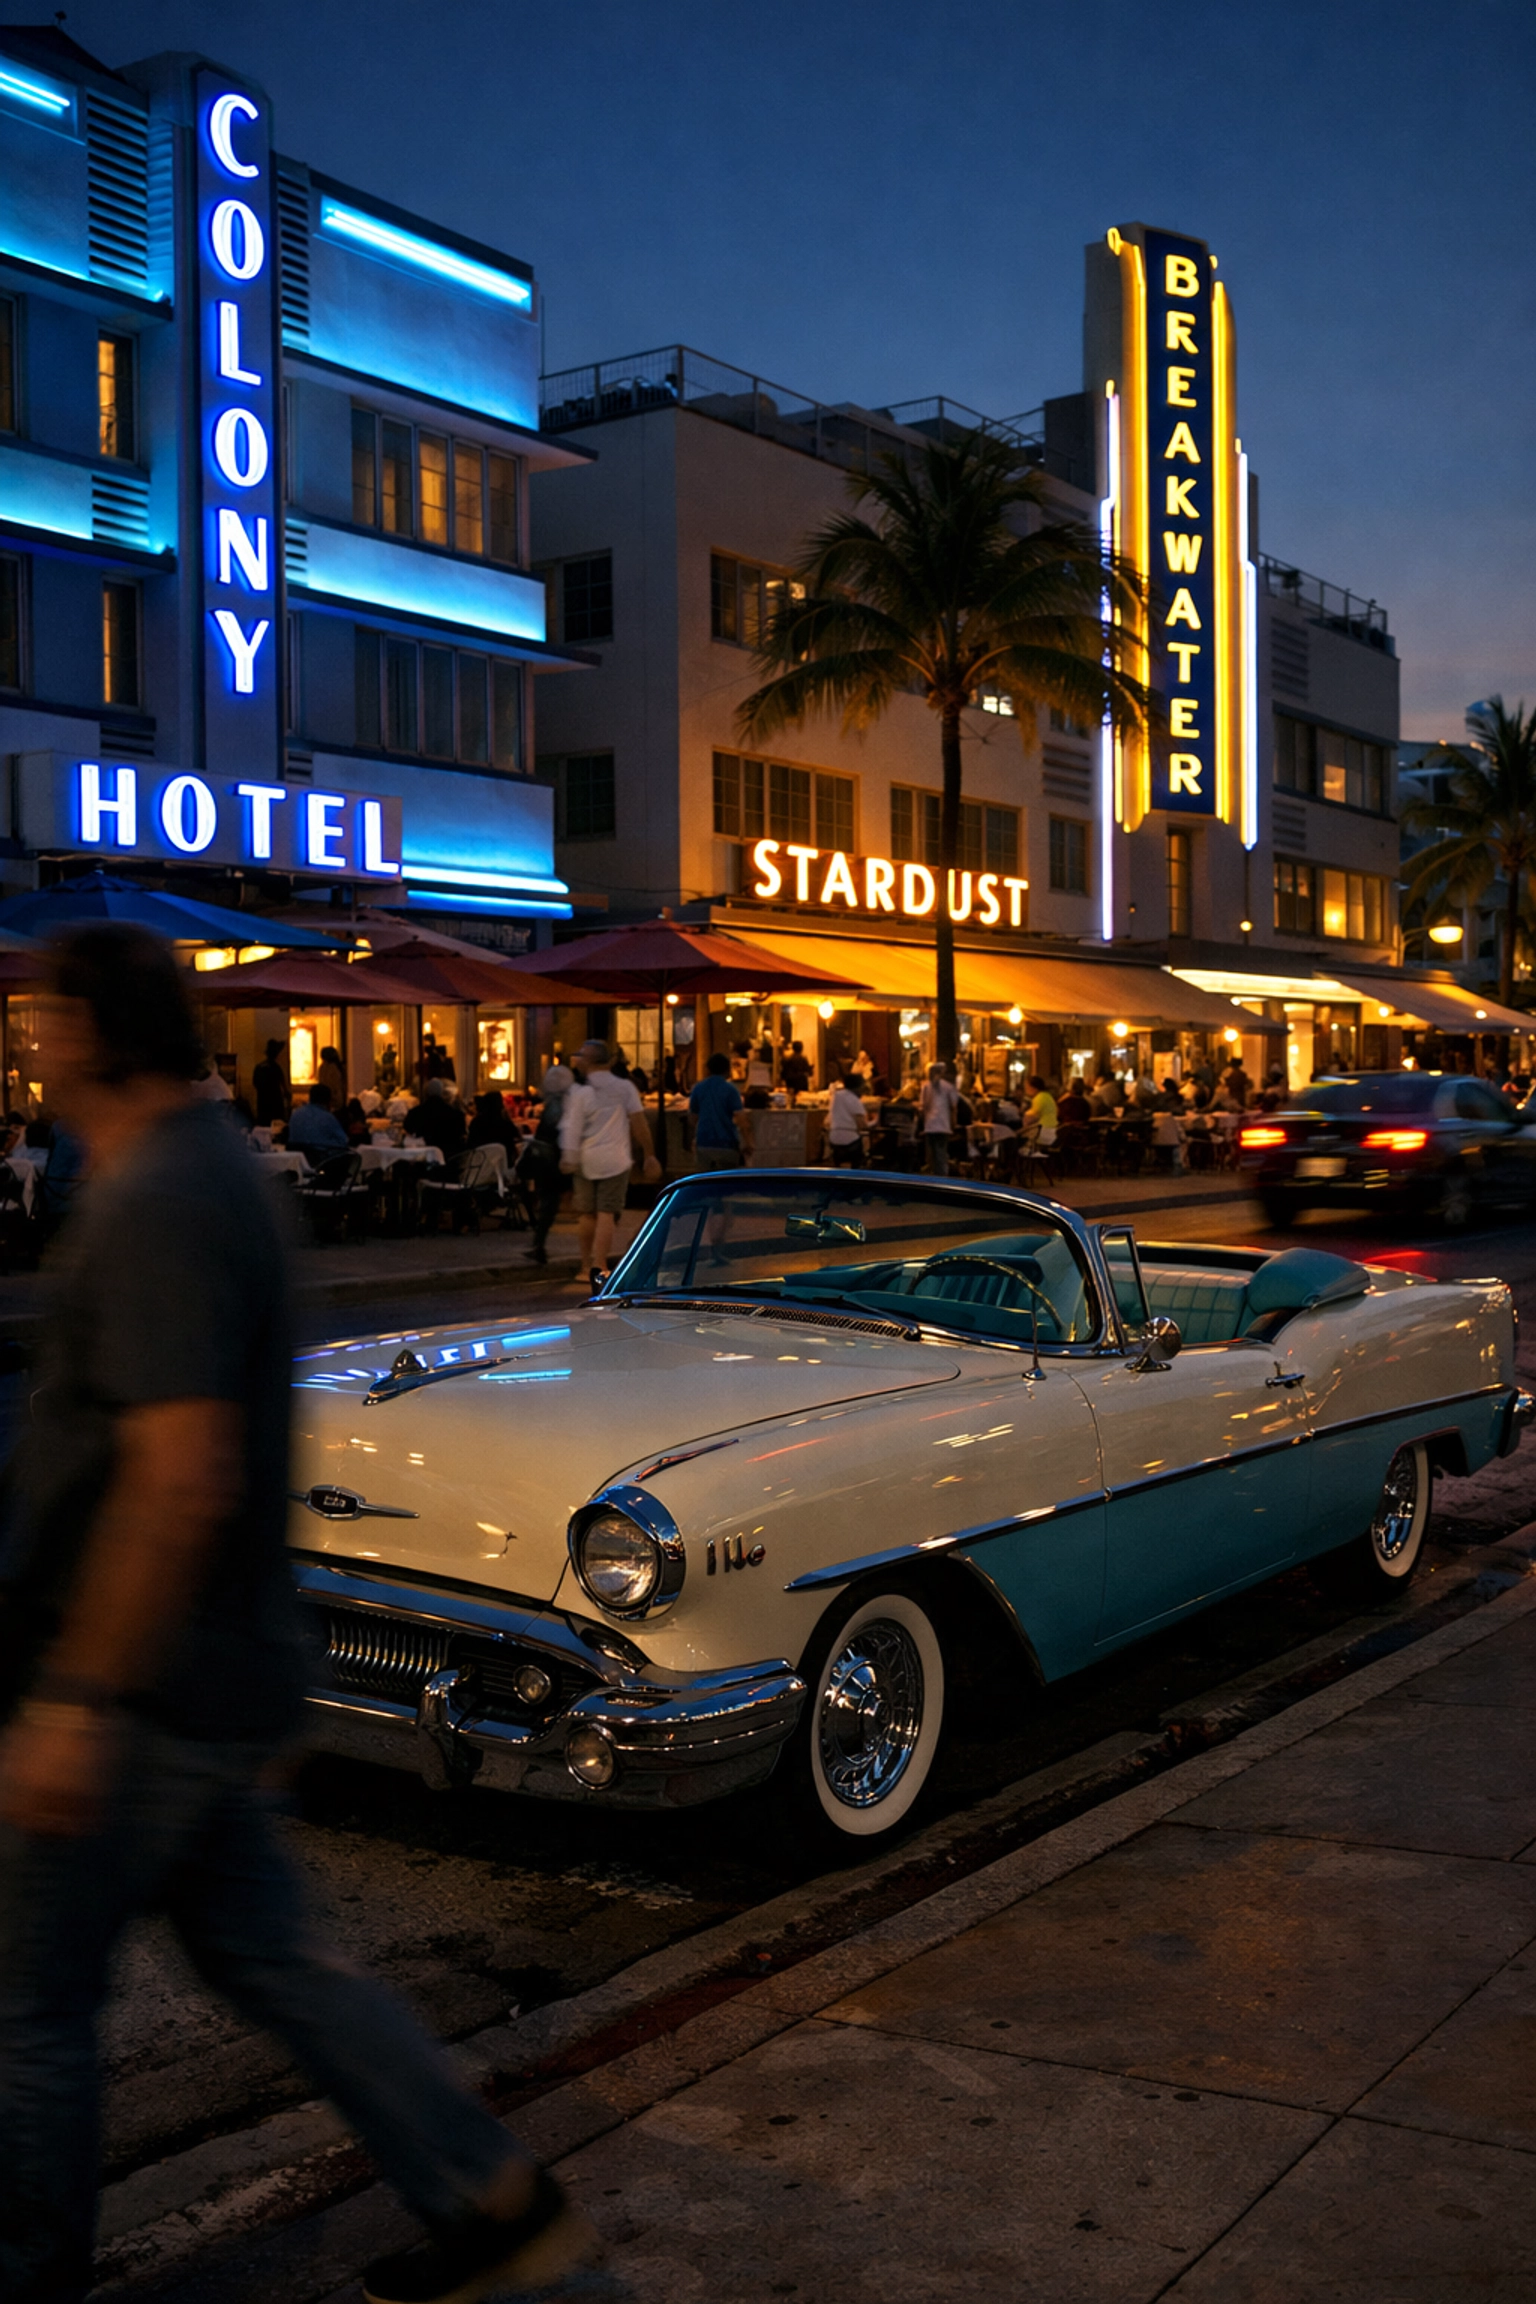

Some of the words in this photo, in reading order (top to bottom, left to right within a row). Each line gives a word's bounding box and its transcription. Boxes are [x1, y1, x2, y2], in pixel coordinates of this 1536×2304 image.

[208, 93, 270, 694] COLONY
[1162, 253, 1204, 796] BREAKWATER
[77, 762, 401, 875] HOTEL
[752, 837, 1030, 928] STARDUST
